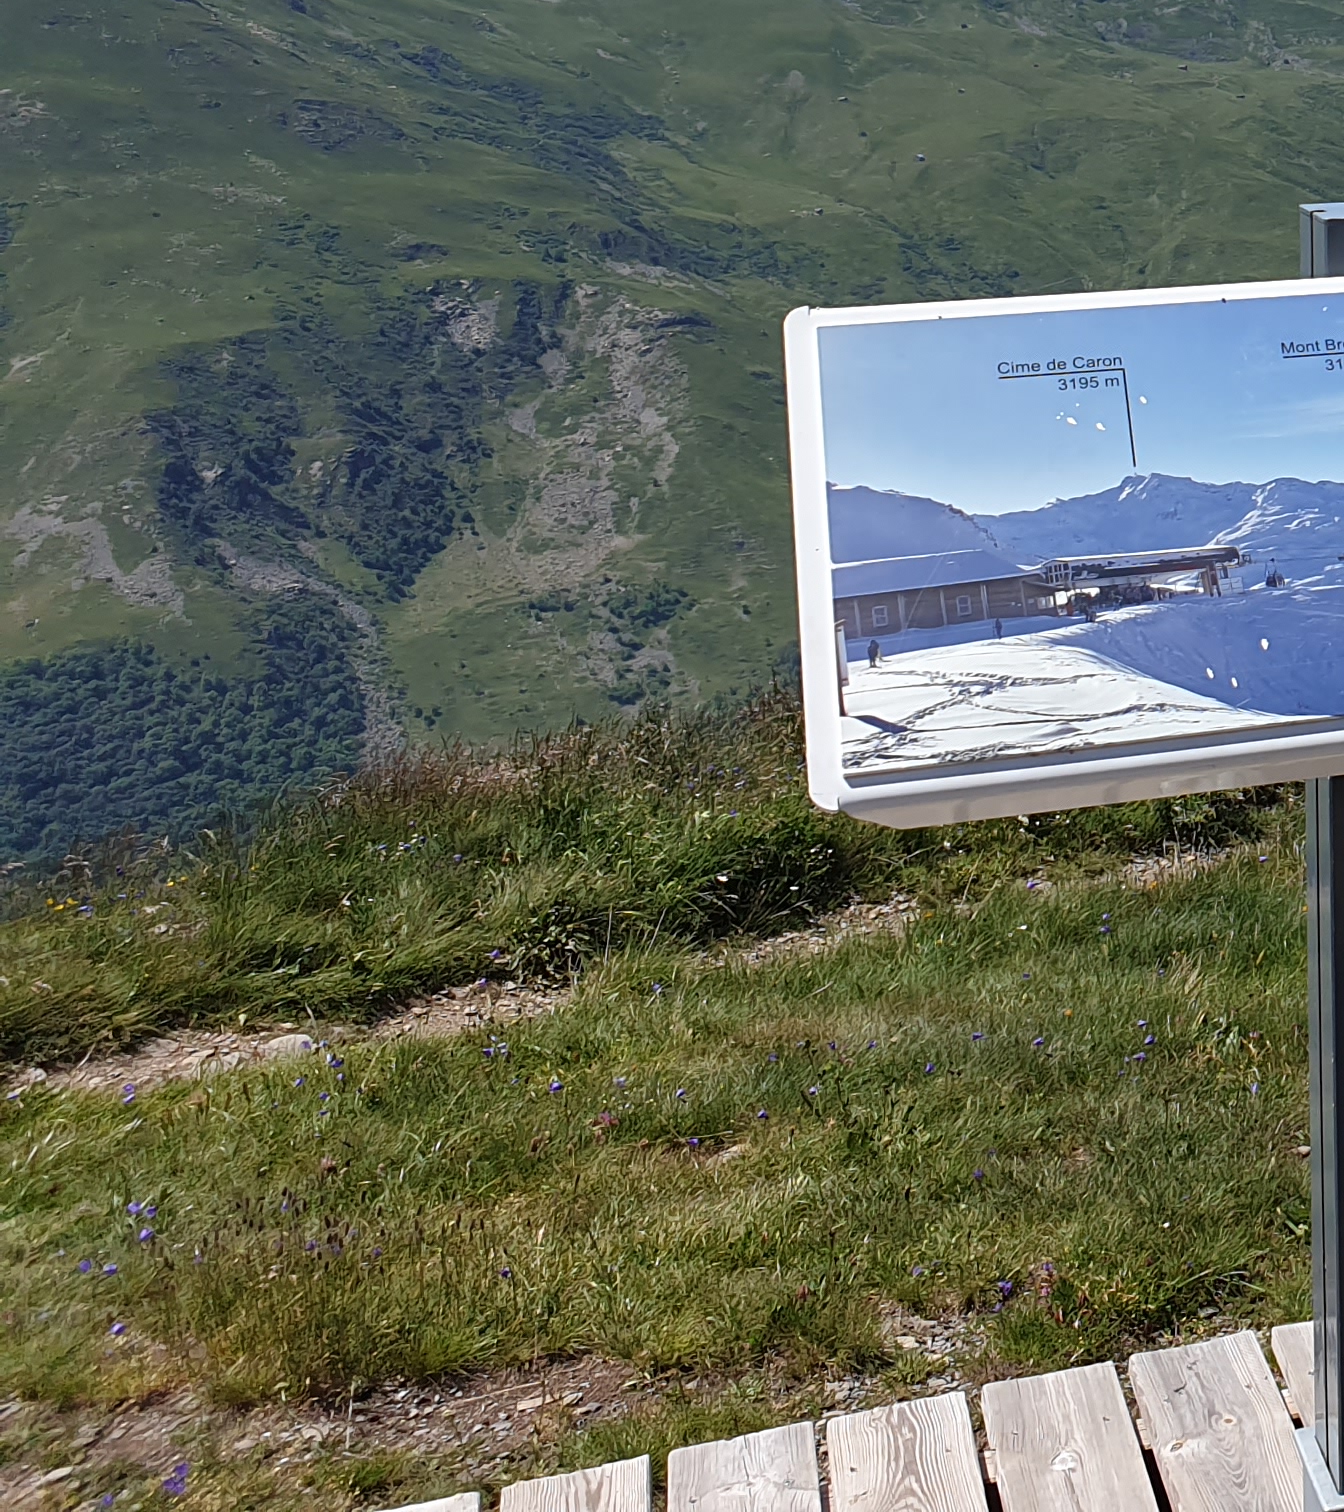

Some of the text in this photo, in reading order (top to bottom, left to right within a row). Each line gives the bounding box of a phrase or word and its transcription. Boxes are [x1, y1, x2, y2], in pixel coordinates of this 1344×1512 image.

[1281, 339, 1321, 355] Mont
[997, 353, 1124, 375] Cime de Caron
[1057, 375, 1121, 392] 3195 m
